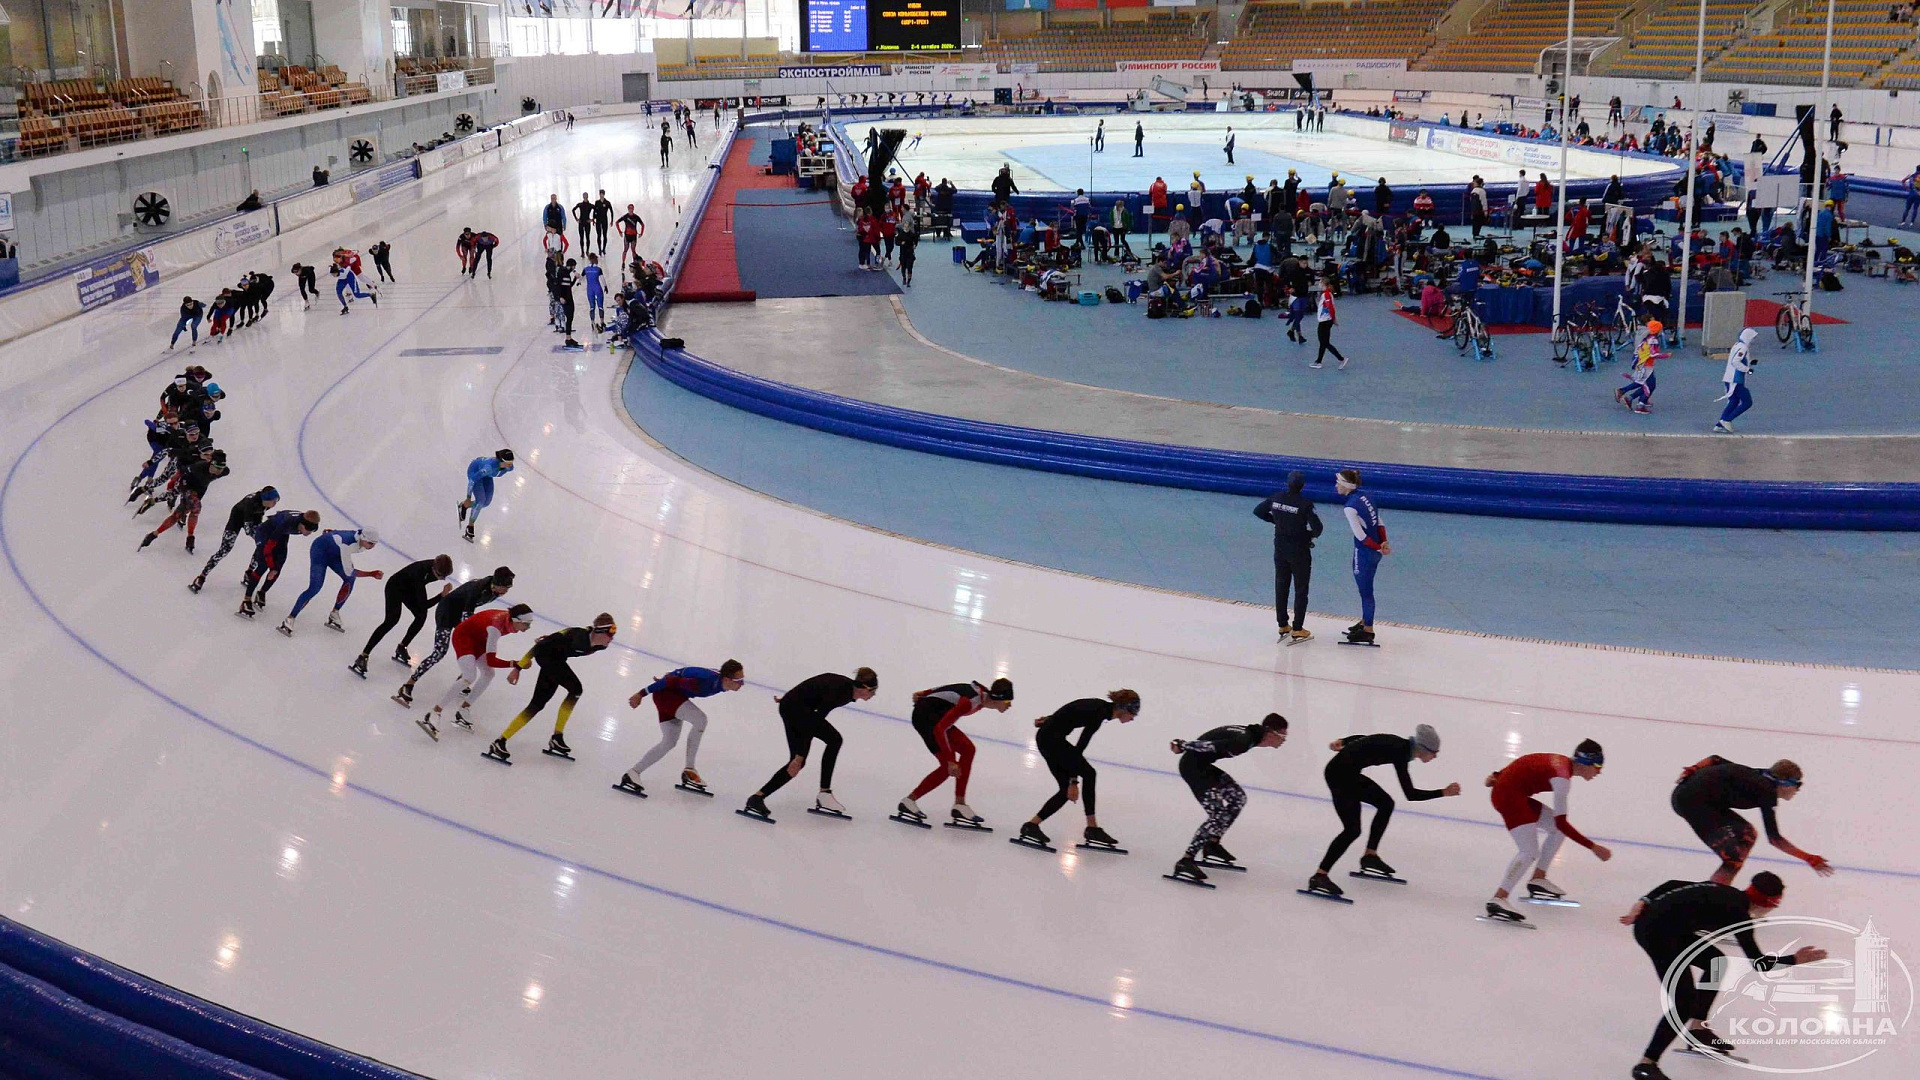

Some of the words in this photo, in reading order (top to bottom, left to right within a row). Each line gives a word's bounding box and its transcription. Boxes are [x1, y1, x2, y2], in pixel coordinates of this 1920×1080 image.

[780, 66, 881, 78] ЭКСПОСТРОЙМАШ
[1128, 62, 1178, 71] МИНСПОРТ
[1181, 62, 1217, 70] РОССИИ
[1360, 496, 1377, 526] RUSSIA
